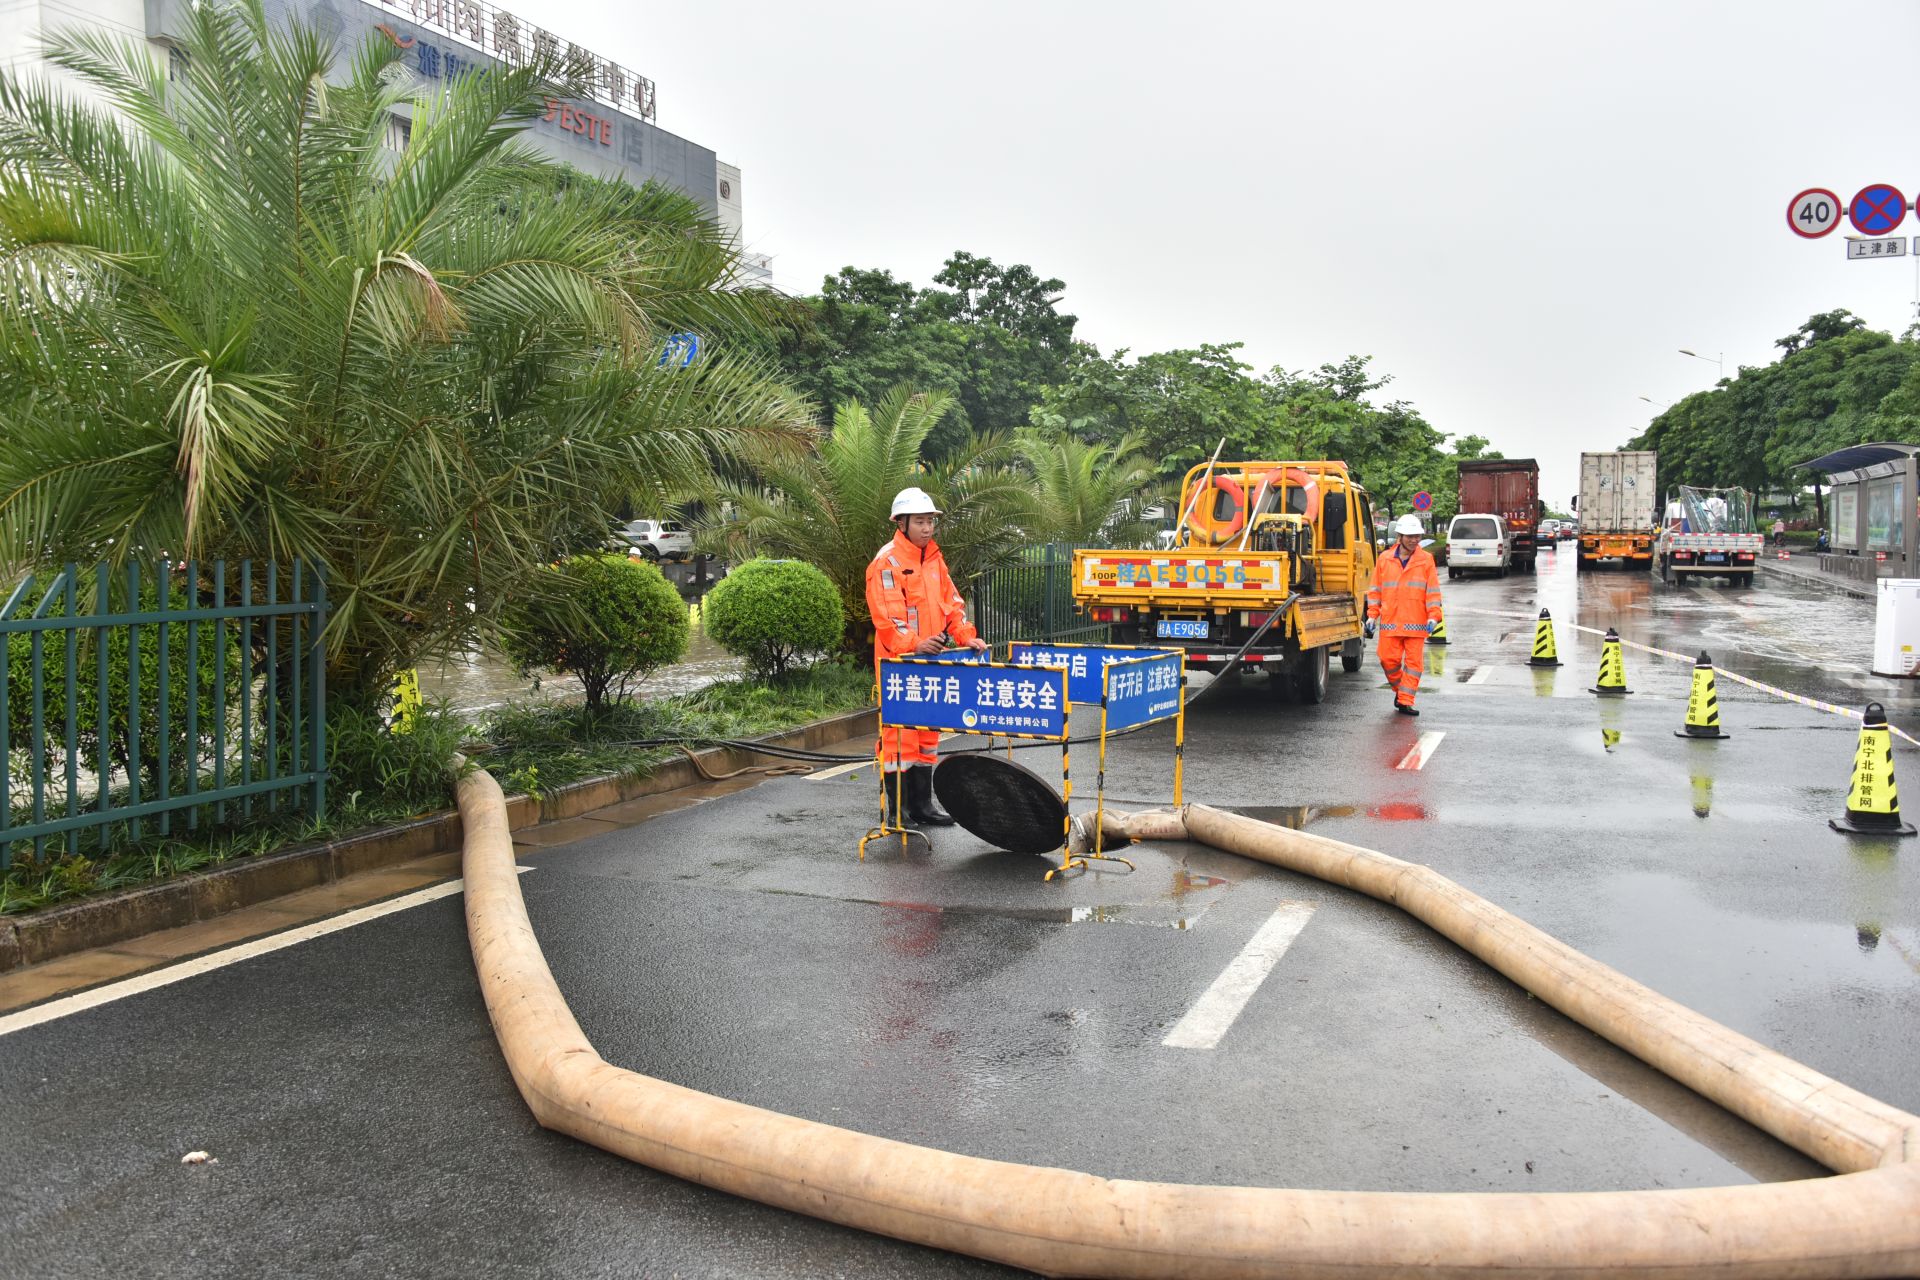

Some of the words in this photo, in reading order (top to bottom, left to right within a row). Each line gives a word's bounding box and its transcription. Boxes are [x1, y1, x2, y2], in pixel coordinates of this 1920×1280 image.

[1799, 201, 1830, 224] 40
[1855, 241, 1898, 256] 上津路
[1147, 663, 1178, 693] 注意安全
[886, 673, 961, 705] 井盖开启
[976, 678, 1057, 710] 注意安全
[980, 715, 1049, 728] 南宁北排管网公司
[1859, 736, 1876, 808] 南宁北排管网
